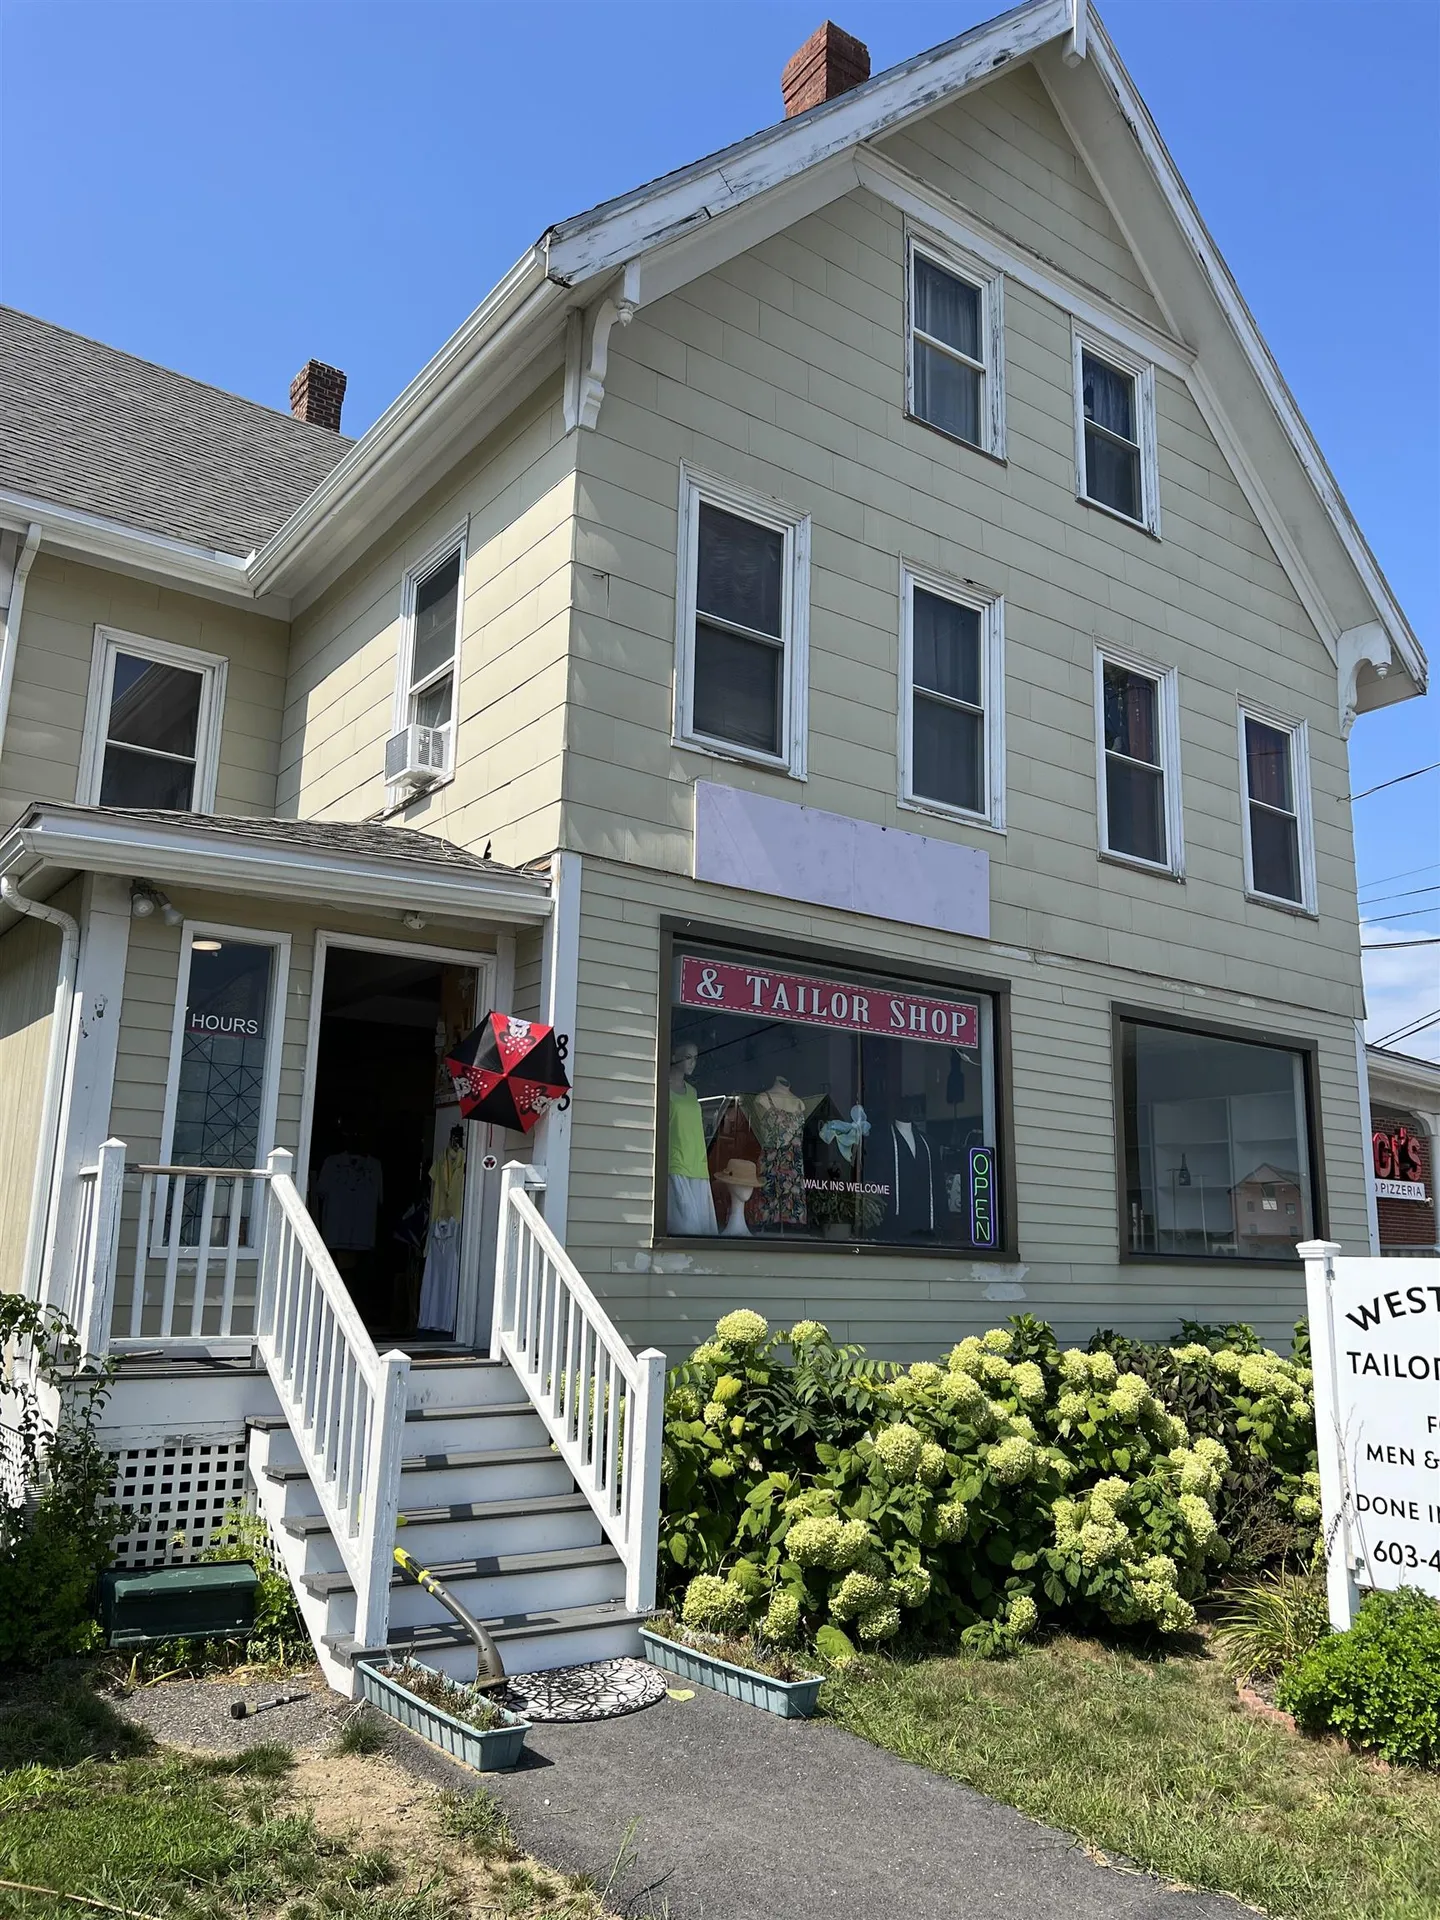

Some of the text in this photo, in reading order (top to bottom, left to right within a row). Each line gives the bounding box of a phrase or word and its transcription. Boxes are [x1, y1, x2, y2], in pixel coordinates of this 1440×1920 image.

[697, 968, 967, 1038] & TAILOR SHOP
[191, 1013, 258, 1035] HOURS
[802, 1179, 890, 1195] WALK INS WELCOME
[972, 1153, 990, 1242] OPEN
[1380, 1182, 1423, 1197] PIZZERIA
[1427, 1415, 1440, 1434] F
[1366, 1443, 1440, 1470] MEN &
[1356, 1493, 1420, 1521] DONE
